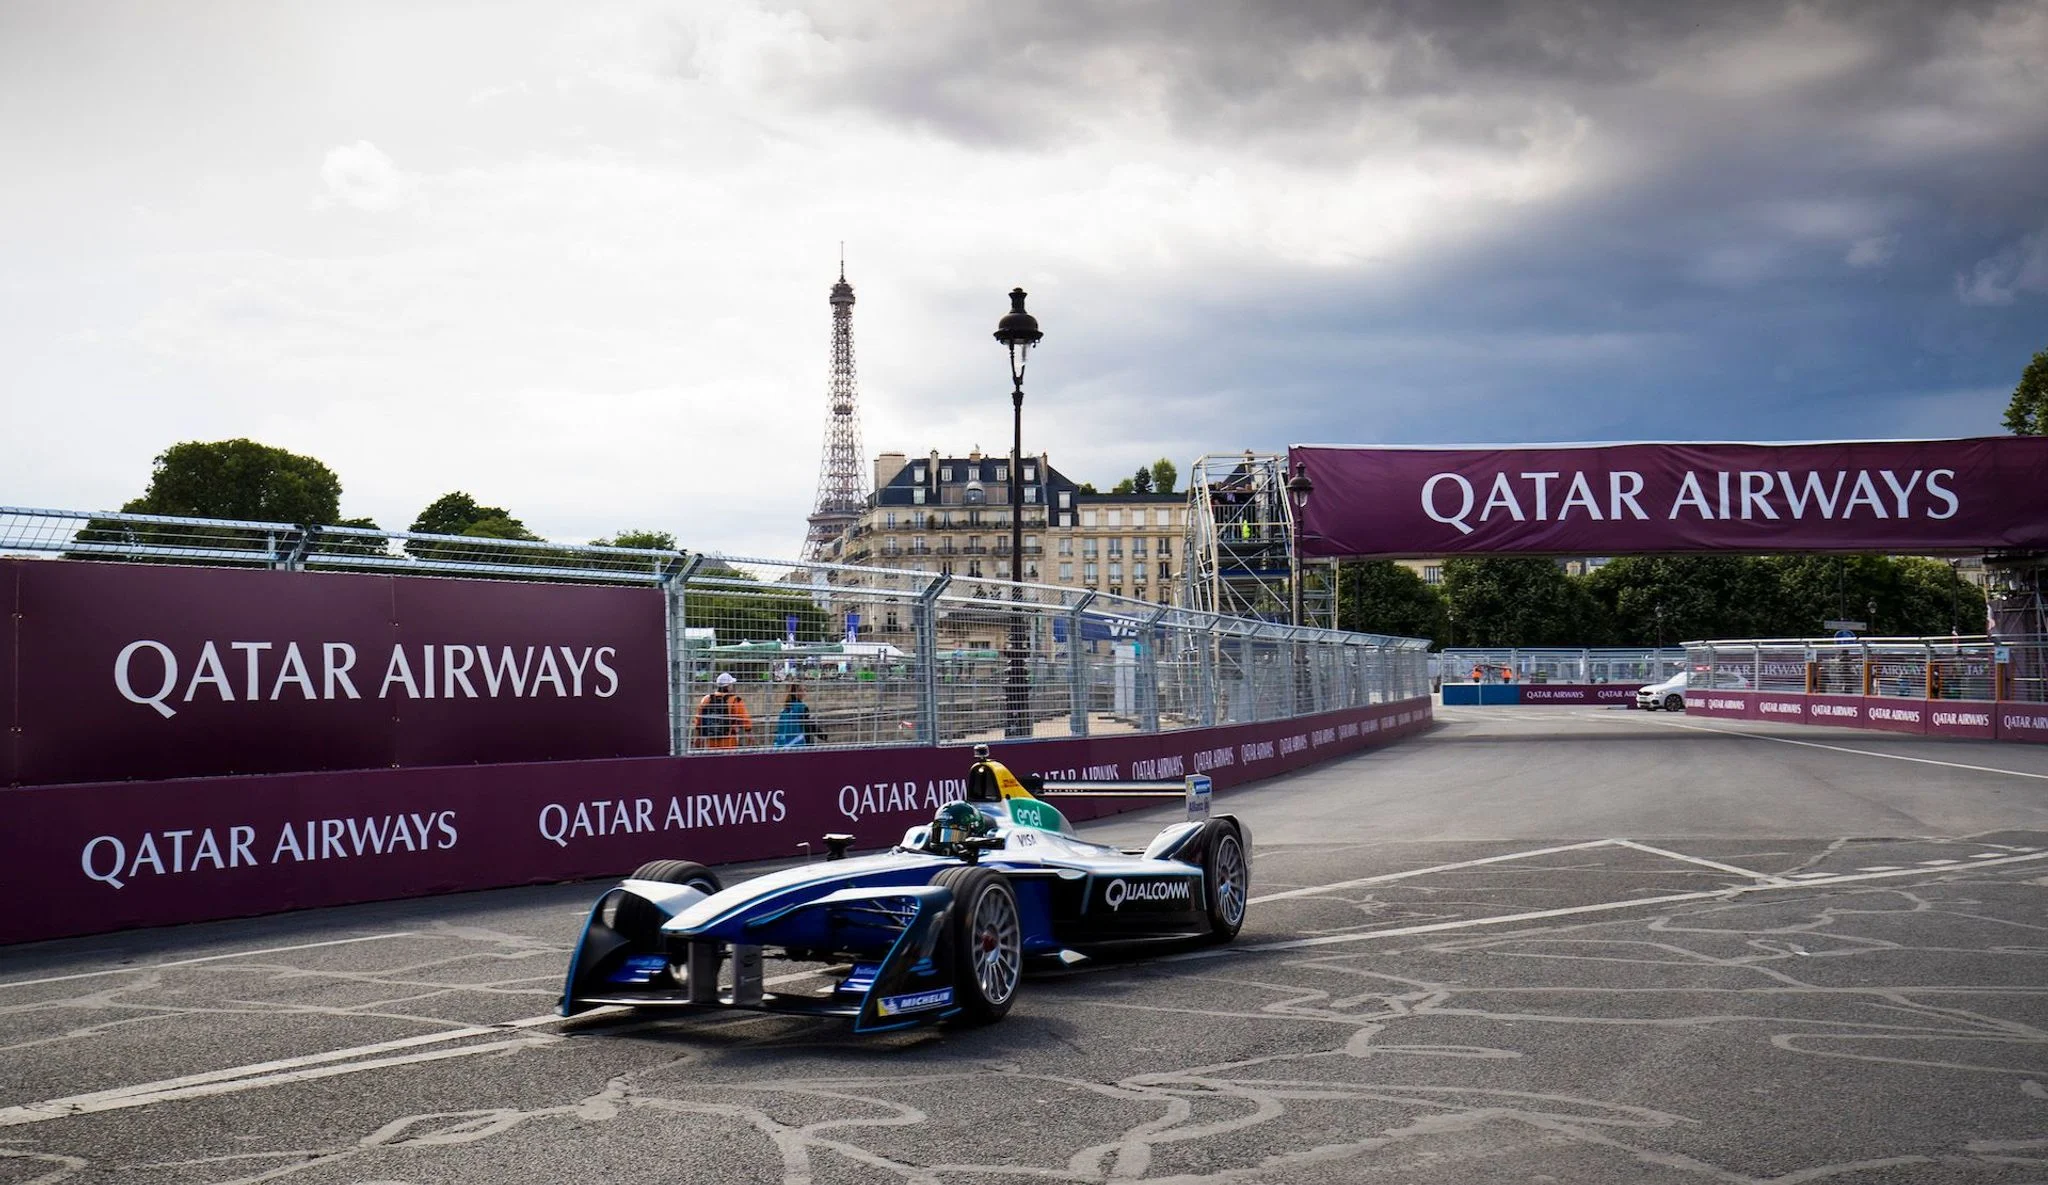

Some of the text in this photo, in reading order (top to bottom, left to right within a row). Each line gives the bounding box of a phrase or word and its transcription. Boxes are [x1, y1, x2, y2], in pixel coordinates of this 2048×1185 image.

[1421, 469, 1958, 535] QATAR AIRWAYS
[114, 640, 618, 719] QATAR AIRWAYS
[1526, 690, 1585, 699] QATAR AIRWAYS
[1597, 690, 1622, 699] QATAR
[1811, 704, 1832, 717] QATAR
[1868, 707, 1921, 723] QATAR AIRWAYS
[1932, 712, 1989, 727] QATAR AIRWAYS
[2003, 715, 2031, 730] QATAR
[838, 778, 968, 822] QATAR AIRW
[539, 789, 787, 848] QATAR AIRWAYS
[1017, 805, 1043, 827] enel
[82, 810, 458, 890] QATAR AIRWAYS
[1016, 834, 1036, 848] VISA
[1105, 878, 1190, 912] QUALCOMM
[900, 991, 951, 1009] MICHELIN
